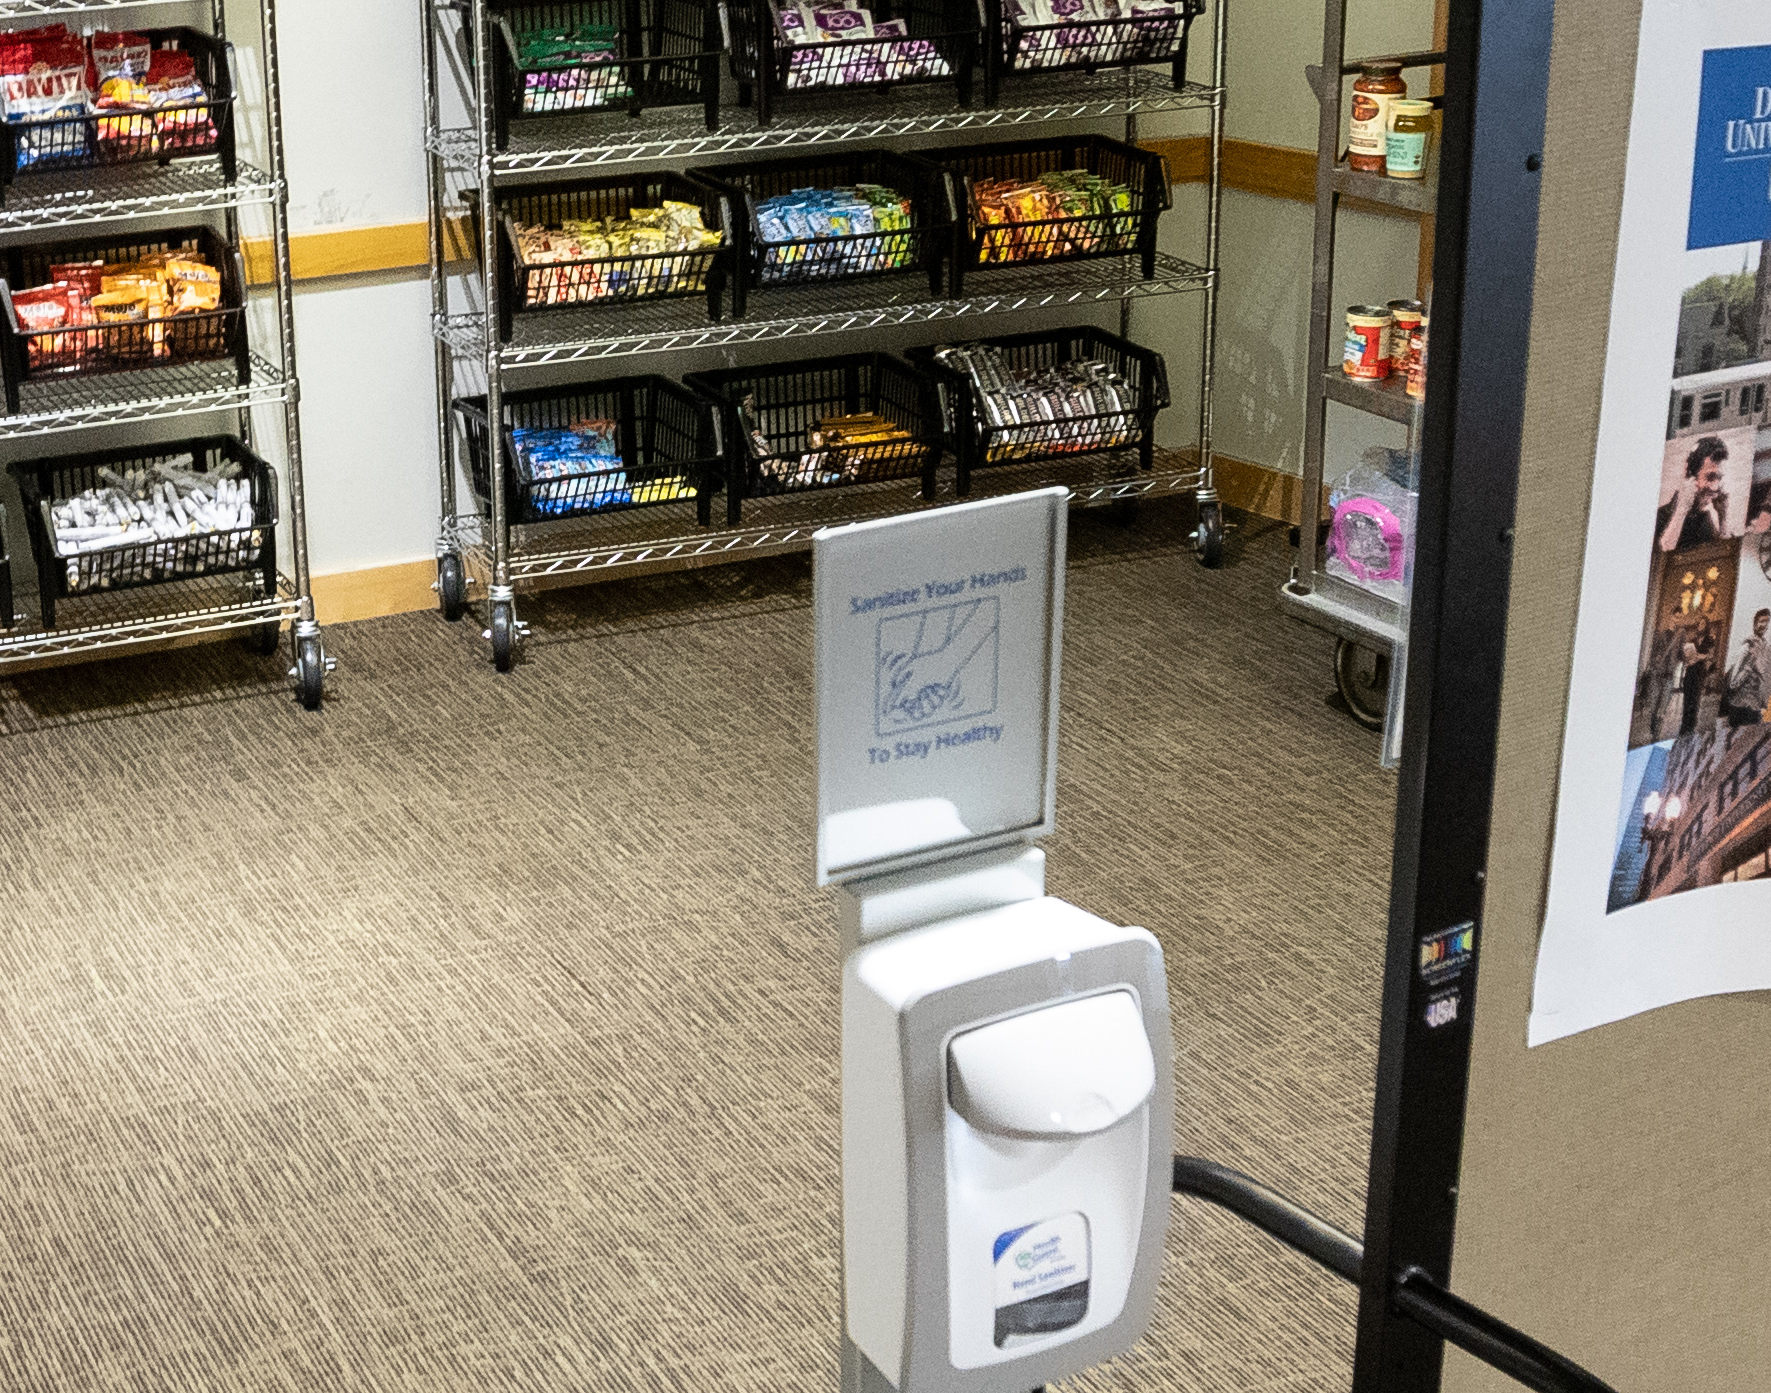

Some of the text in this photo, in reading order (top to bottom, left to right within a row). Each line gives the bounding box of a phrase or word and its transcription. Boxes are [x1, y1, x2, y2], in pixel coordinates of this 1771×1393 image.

[850, 565, 1027, 615] Sanitize Your Hands
[867, 723, 1004, 765] To Stay Healthy
